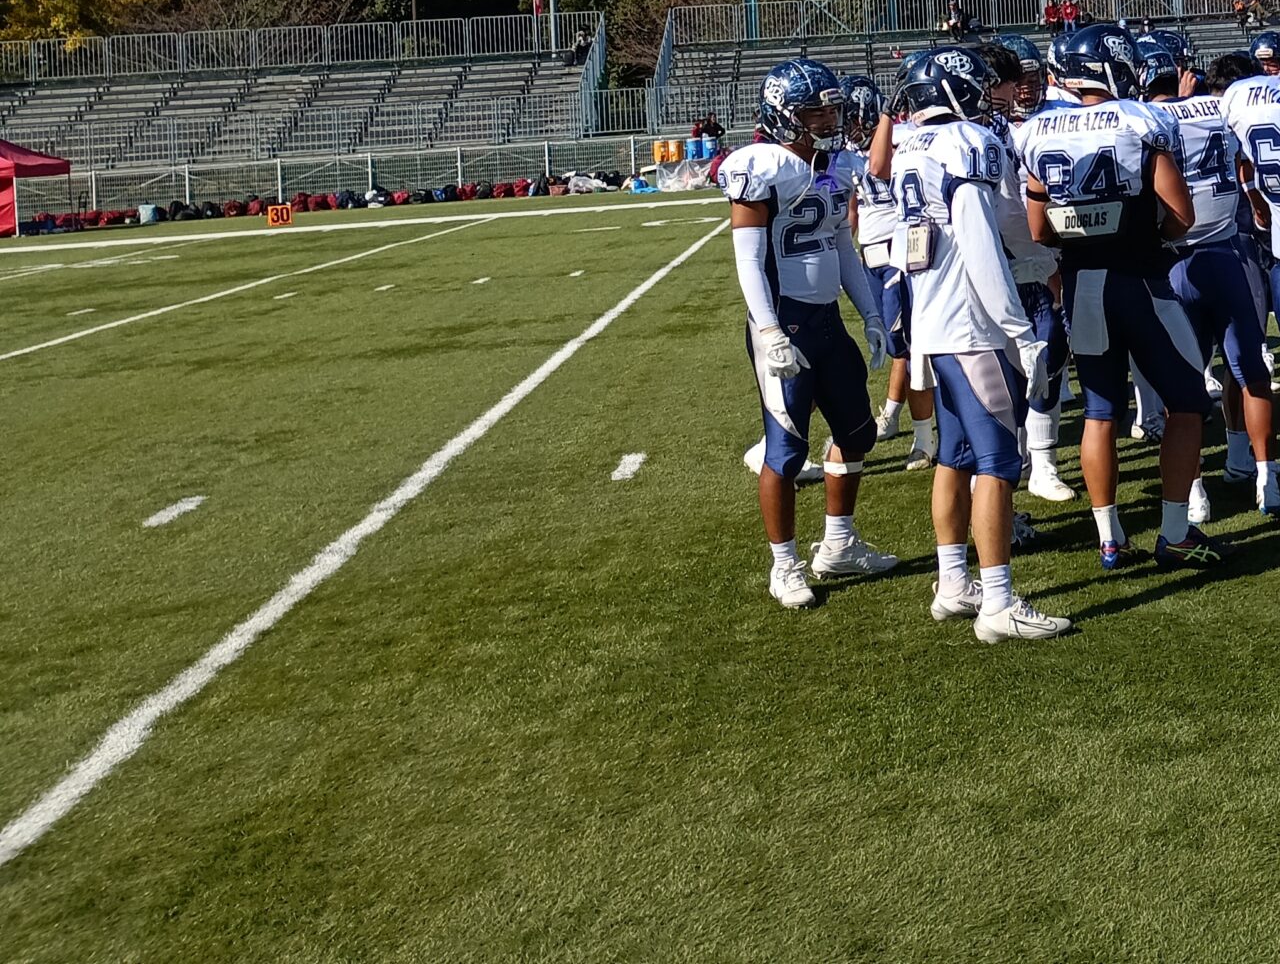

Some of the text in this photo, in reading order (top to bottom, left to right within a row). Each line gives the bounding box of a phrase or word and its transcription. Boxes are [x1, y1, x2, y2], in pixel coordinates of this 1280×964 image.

[966, 144, 1003, 180] 18
[271, 206, 290, 223] 30
[1064, 212, 1108, 230] DOUGLAS
